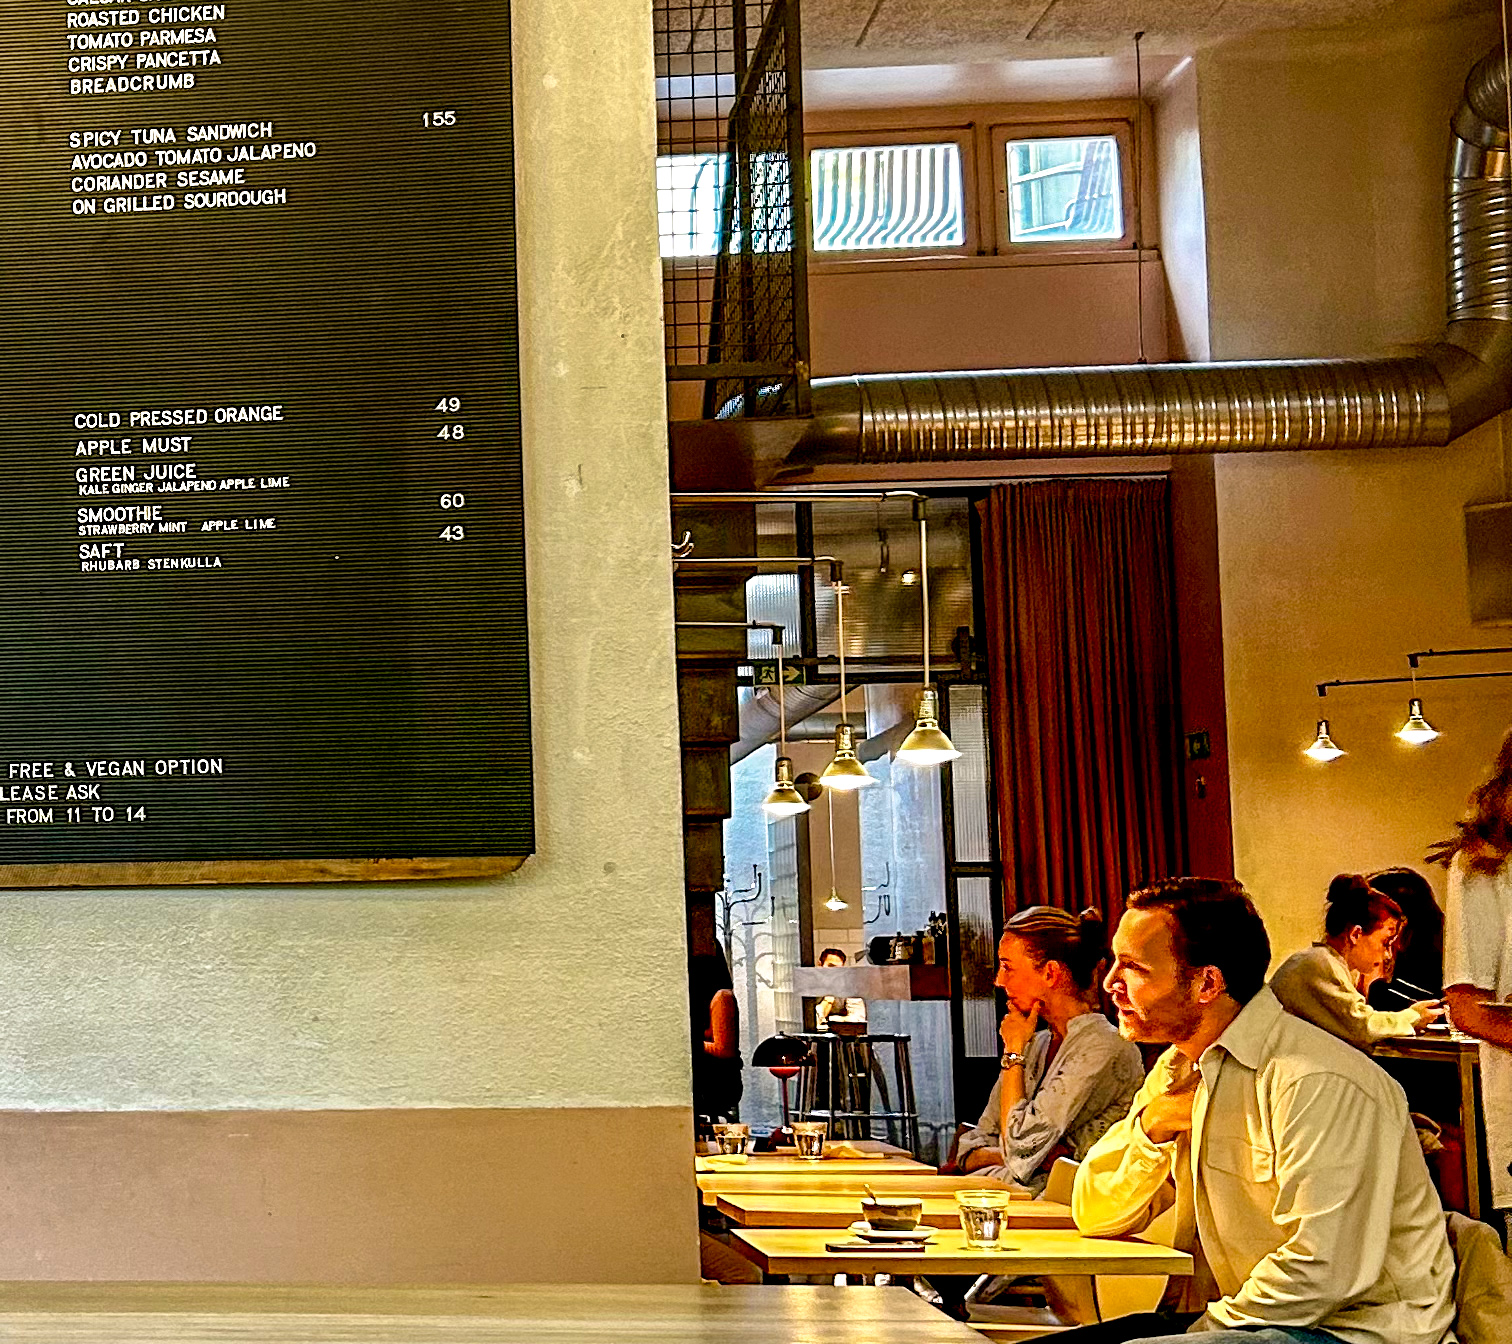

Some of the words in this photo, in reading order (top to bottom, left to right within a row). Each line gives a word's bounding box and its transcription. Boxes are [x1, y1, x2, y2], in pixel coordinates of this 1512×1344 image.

[68, 54, 129, 73] CRISPY
[136, 49, 222, 69] PANCETTA
[70, 73, 195, 95] BREADCRUMB
[423, 110, 456, 128] 155
[69, 129, 122, 148] SPICY
[130, 127, 177, 145] TUNA
[186, 121, 273, 142] SANDWICH
[72, 198, 96, 215] ON
[103, 194, 175, 214] GRILLED
[183, 188, 287, 210] SOURDOUGH
[434, 397, 461, 413] 49
[74, 412, 121, 429] COLD
[130, 408, 208, 427] PRESSED
[214, 405, 284, 424] ORANGE
[436, 424, 465, 440] 48
[75, 438, 132, 456] APPLE
[142, 436, 193, 454] MUST
[75, 465, 135, 483] GREEN
[143, 463, 197, 481] JUICE
[78, 483, 110, 496] KALE
[111, 482, 154, 494] GINGER
[218, 477, 256, 491] APPLE
[260, 476, 290, 489] LIME
[440, 493, 465, 509] 60
[77, 505, 163, 524] SMOOTHIE
[78, 522, 155, 536] STRAWBERRY
[158, 521, 188, 533] MINT
[200, 519, 239, 532] APPLE
[244, 518, 276, 530] LIME
[438, 525, 464, 541] 43
[78, 542, 125, 560] SAFT
[81, 558, 140, 572] RHUBARB
[147, 556, 222, 570] STENKULLA
[9, 762, 54, 779] FREE
[64, 761, 76, 778] &
[85, 760, 145, 777] VEGAN
[155, 758, 223, 775] OPTION
[65, 783, 101, 800] ASK
[6, 807, 53, 824] FROM
[66, 807, 80, 823] 11
[91, 806, 114, 823] TO
[126, 806, 147, 822] 14
